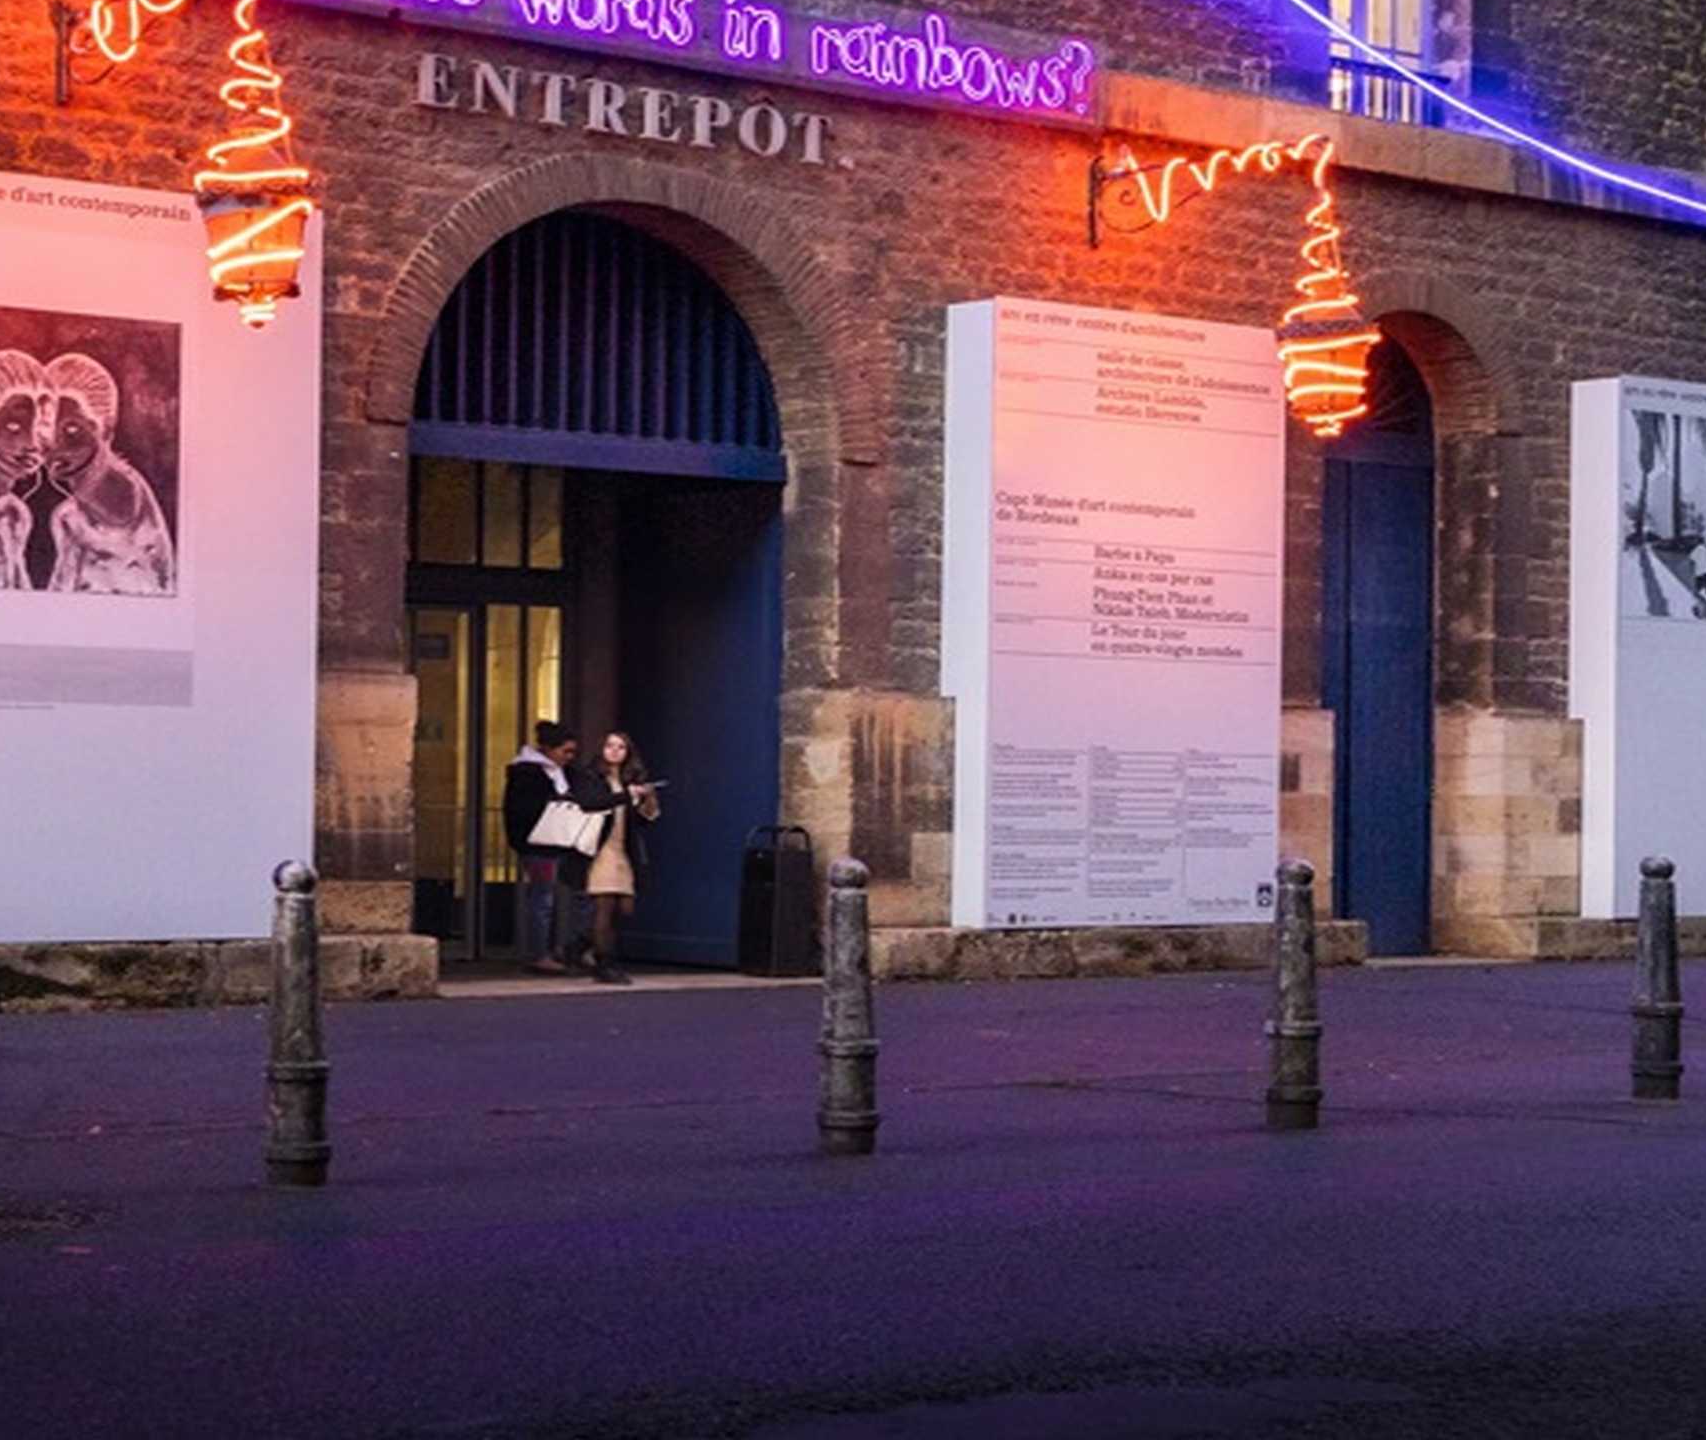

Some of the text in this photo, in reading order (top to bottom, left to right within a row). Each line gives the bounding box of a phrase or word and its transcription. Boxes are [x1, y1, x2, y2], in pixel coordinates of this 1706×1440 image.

[812, 15, 1094, 115] rainbows?
[10, 186, 54, 206] d'art
[59, 193, 192, 222] contemporain
